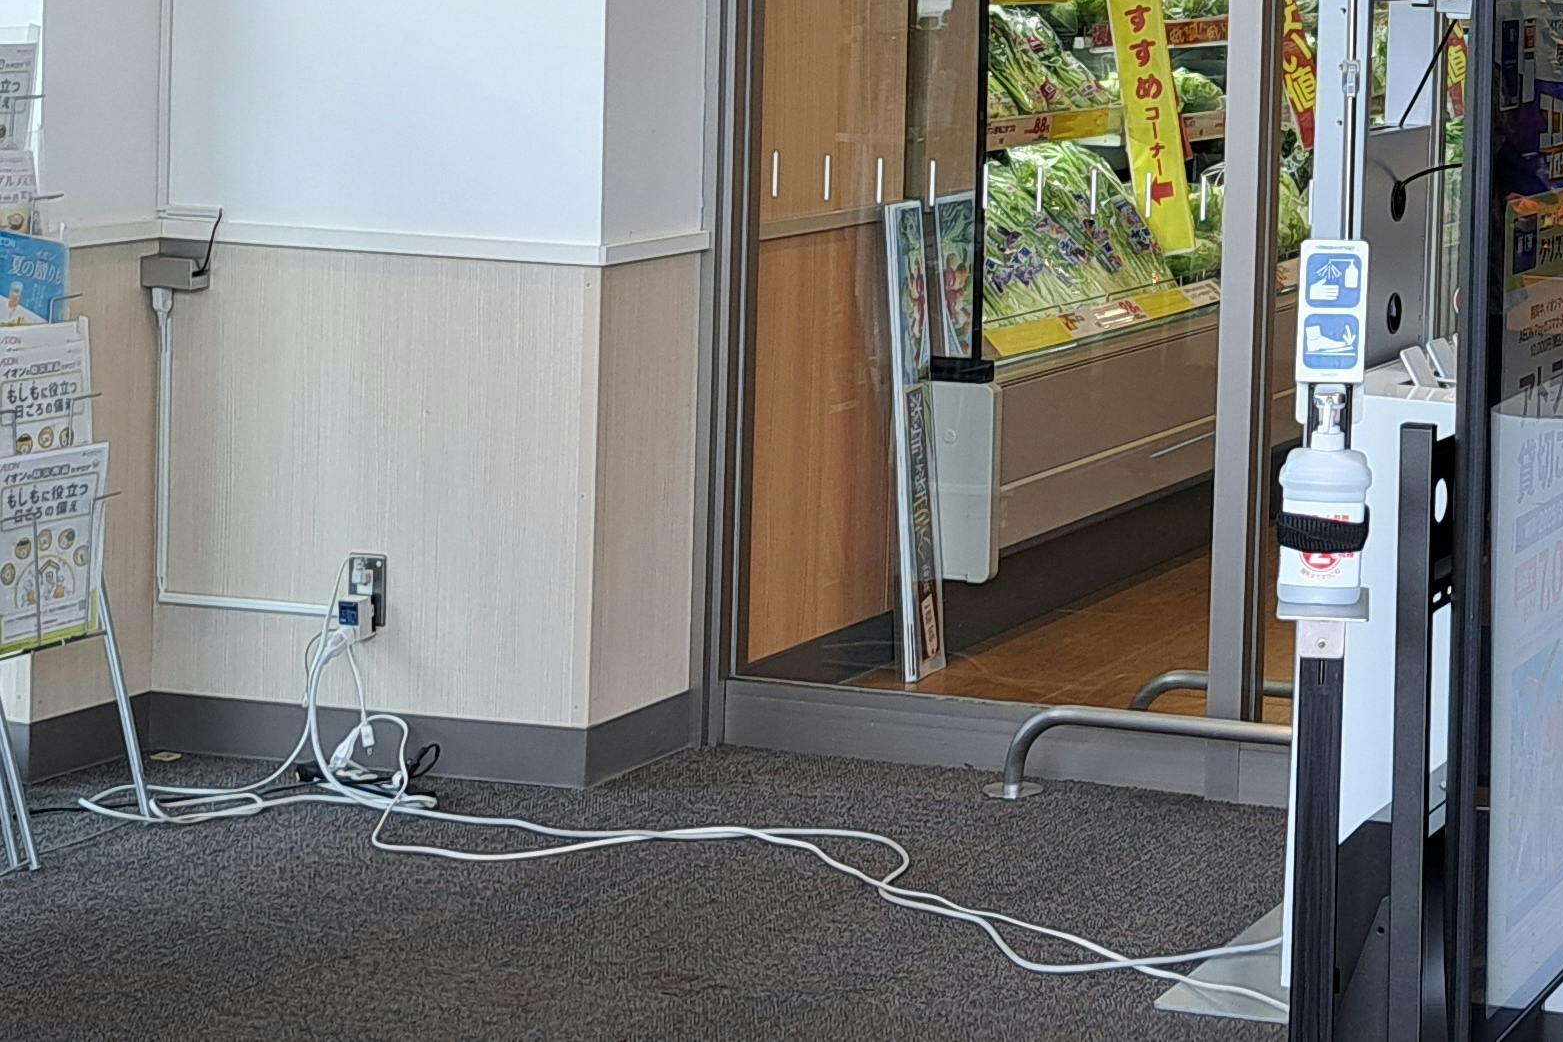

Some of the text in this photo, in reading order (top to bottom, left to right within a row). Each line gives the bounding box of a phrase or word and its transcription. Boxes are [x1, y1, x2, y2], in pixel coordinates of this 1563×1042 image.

[7, 381, 78, 404] もしもに役立つ
[7, 484, 89, 509] もしもに役立つ
